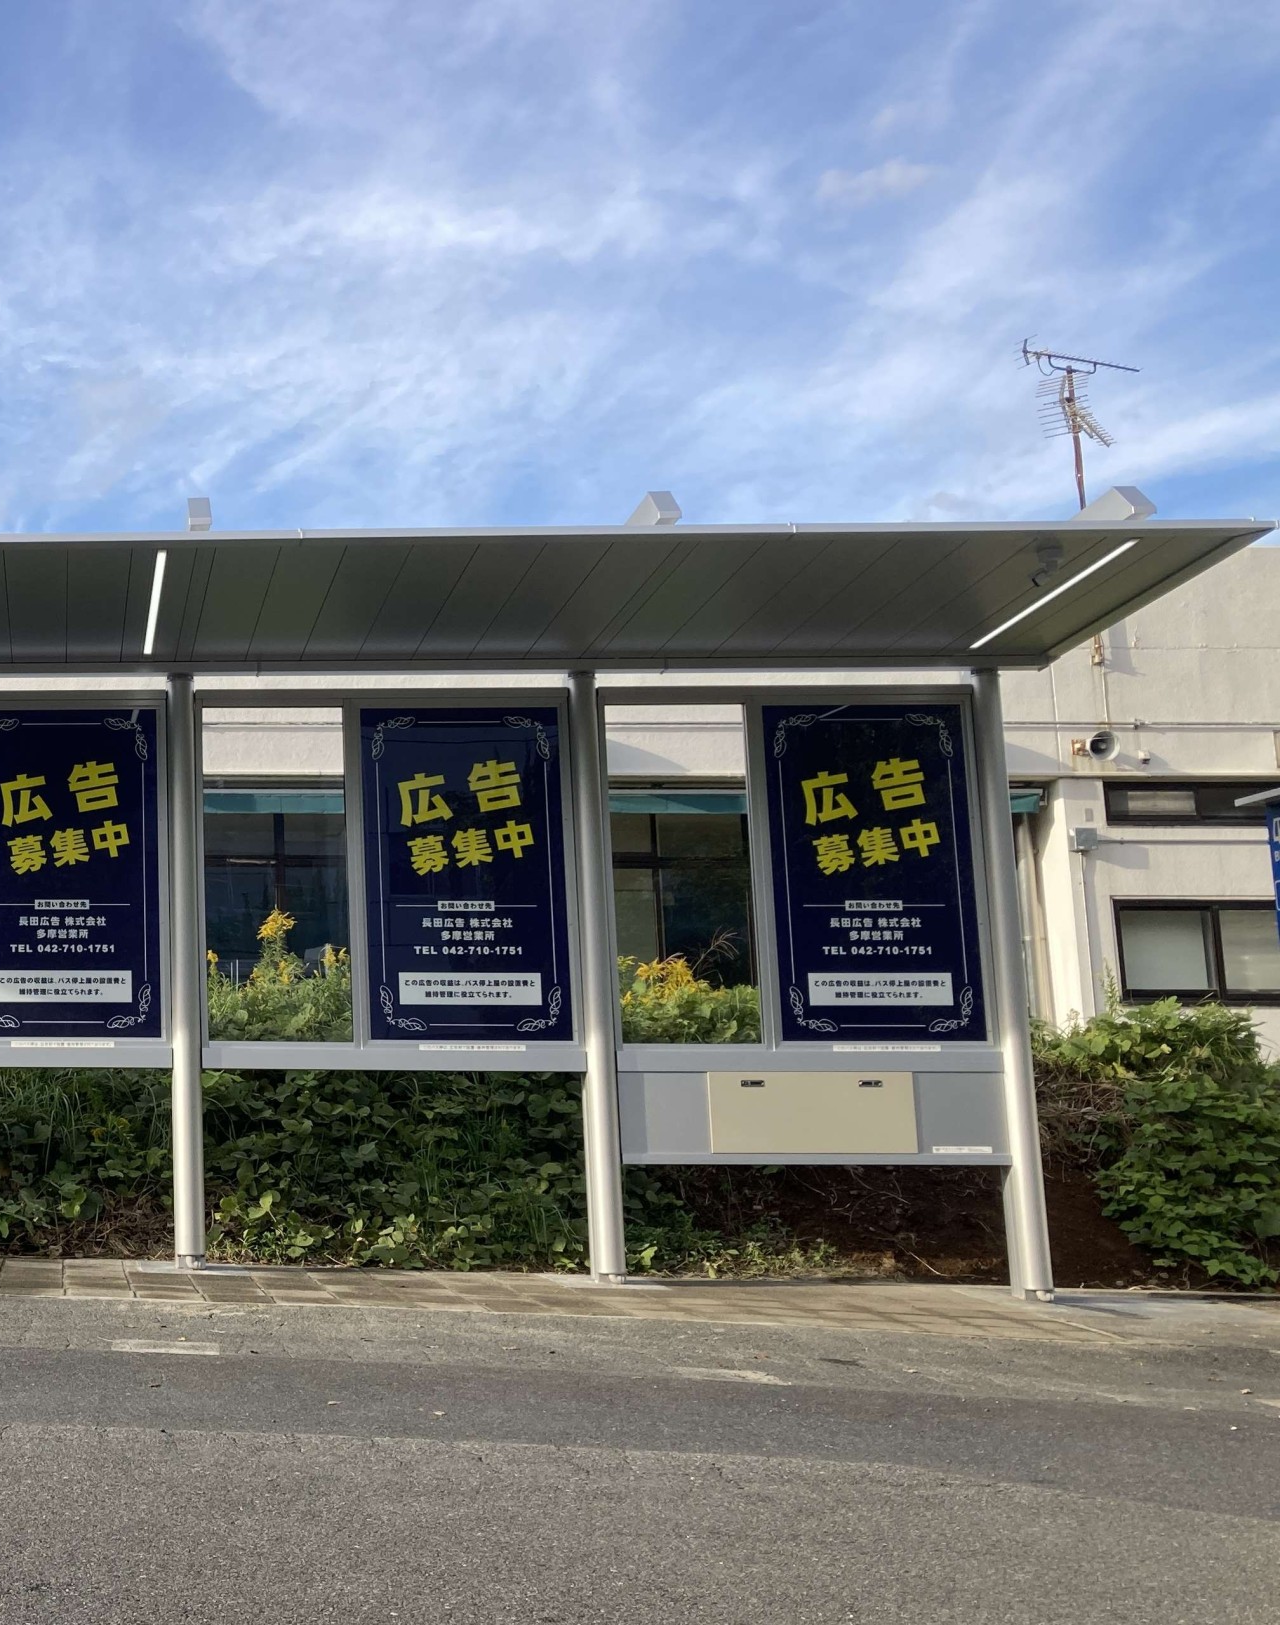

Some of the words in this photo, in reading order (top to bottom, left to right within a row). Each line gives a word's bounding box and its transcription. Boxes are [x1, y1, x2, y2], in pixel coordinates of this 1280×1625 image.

[0, 762, 118, 826] 広告
[399, 760, 521, 827] 広告
[801, 759, 926, 825] 広告
[8, 820, 129, 875] 募集中
[407, 820, 534, 876] 募集中
[814, 818, 940, 876] 募集中
[440, 902, 493, 910] お問い合わせ先
[19, 916, 60, 926] 長田広告
[64, 916, 107, 926] 株式会社
[421, 918, 465, 928] 長田広告
[469, 918, 513, 928] 株式会社
[829, 917, 873, 928] 長田広告
[877, 917, 922, 928] 株式会社
[36, 929, 89, 939] 多摩営業所
[441, 931, 495, 941] 多摩営業所
[849, 931, 904, 941] 多摩営業所
[10, 944, 33, 953] TEL
[37, 944, 115, 953] 042-710-1751
[414, 946, 438, 955] TEL
[442, 946, 523, 955] 042-710-1751
[822, 946, 847, 955] TEL
[851, 946, 933, 955] 042-710-1751
